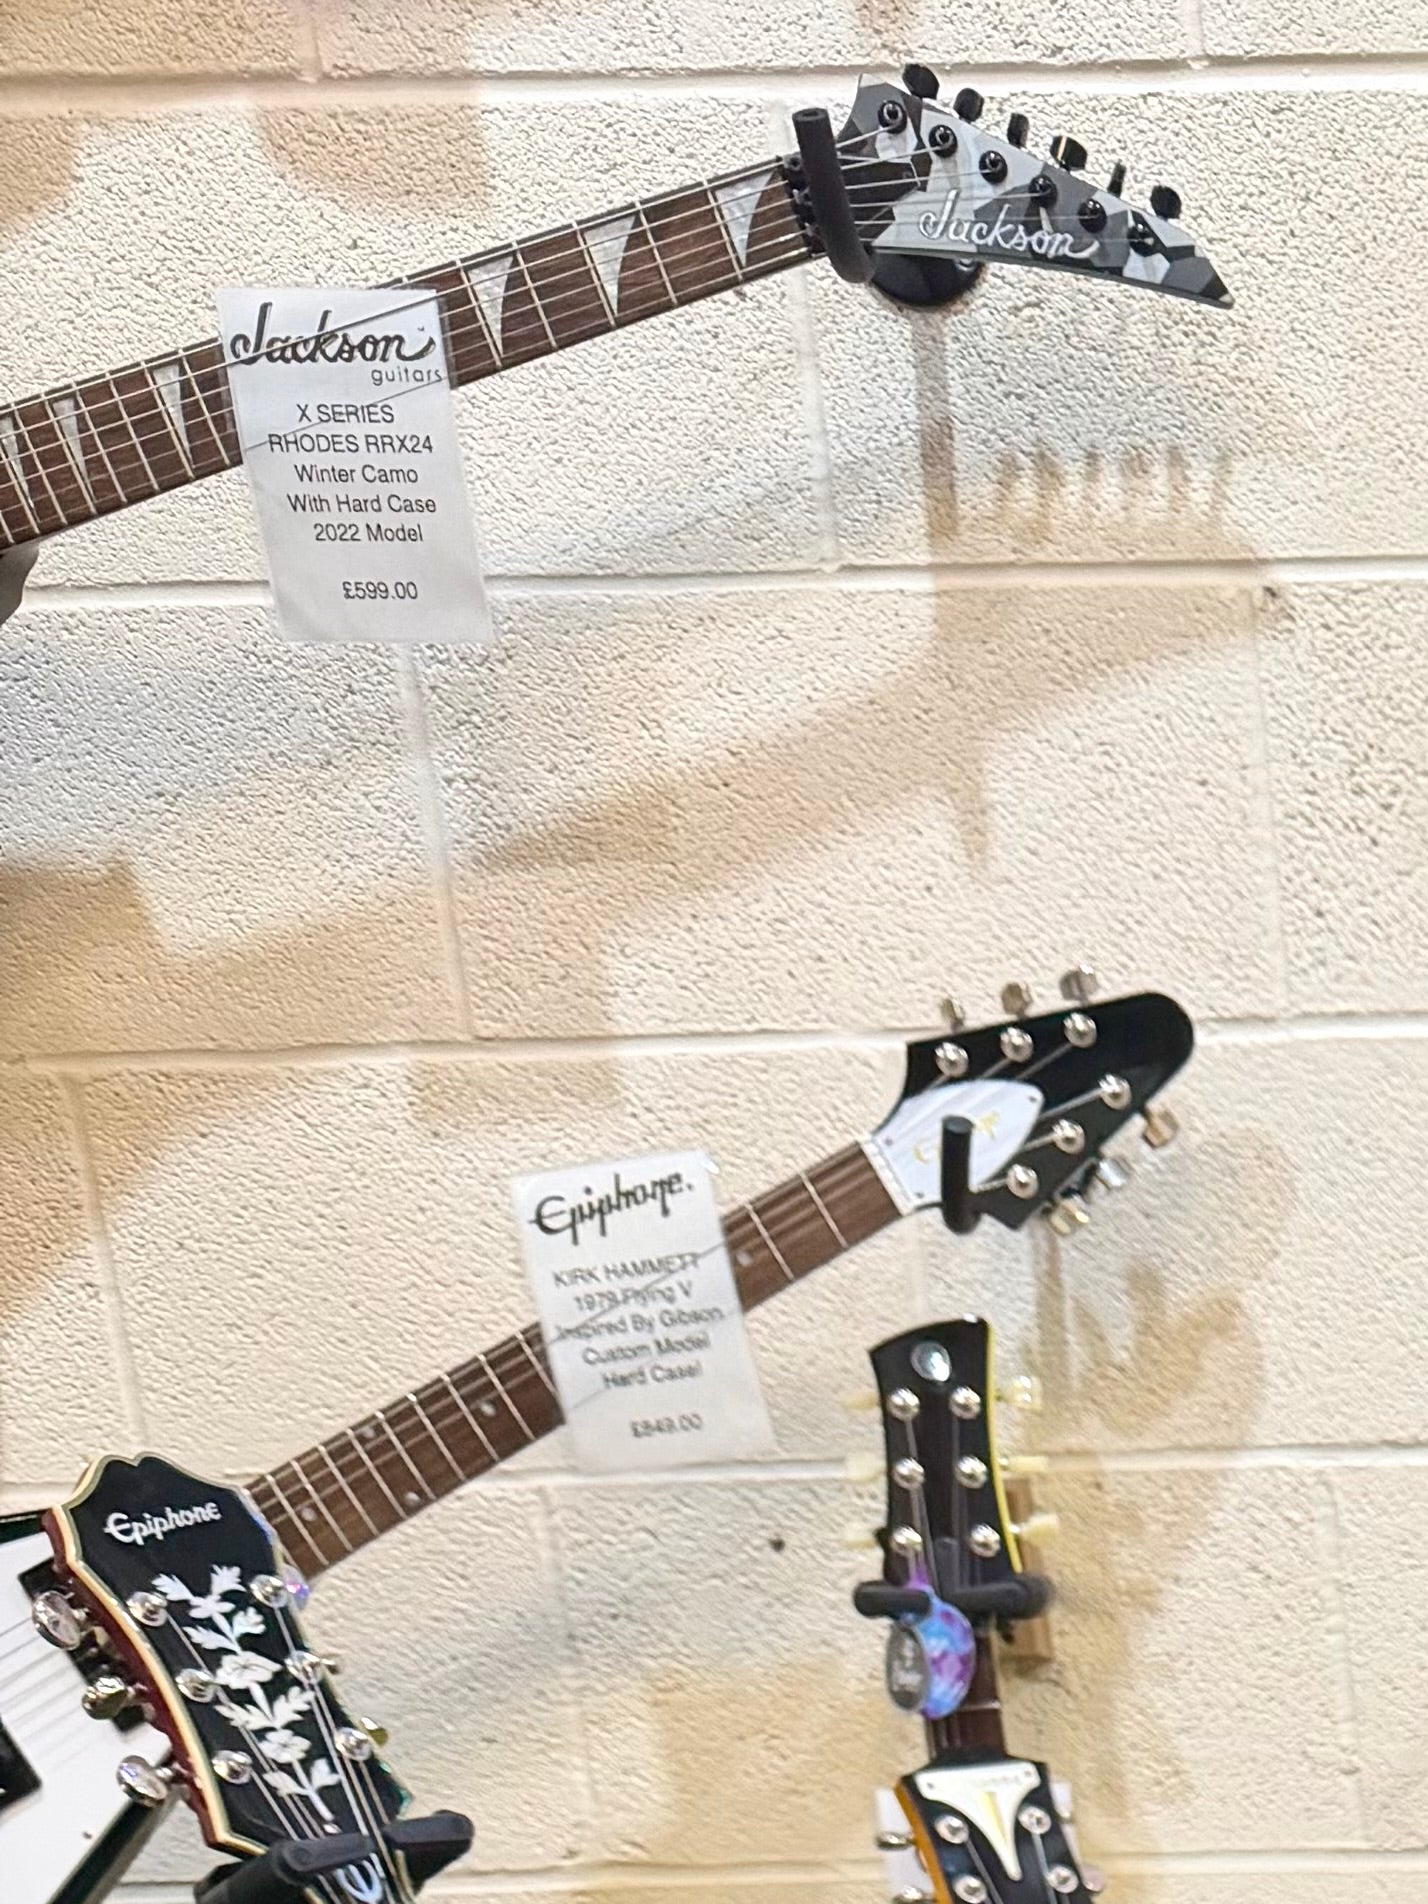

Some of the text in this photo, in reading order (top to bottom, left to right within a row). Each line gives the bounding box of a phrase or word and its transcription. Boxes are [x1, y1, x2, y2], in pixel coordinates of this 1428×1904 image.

[919, 189, 1099, 259] Jackson
[230, 302, 436, 365] Jackson
[371, 366, 443, 386] guitars
[297, 404, 395, 424] X SERIES
[268, 434, 433, 453] RHODES RRX24
[294, 464, 418, 483] Winter Camo
[287, 494, 437, 513] With Hard Case
[314, 523, 424, 542] 2022 Model
[342, 581, 418, 600] £599.00
[553, 1264, 600, 1288] KIRK
[104, 1501, 222, 1545] Epiphone
